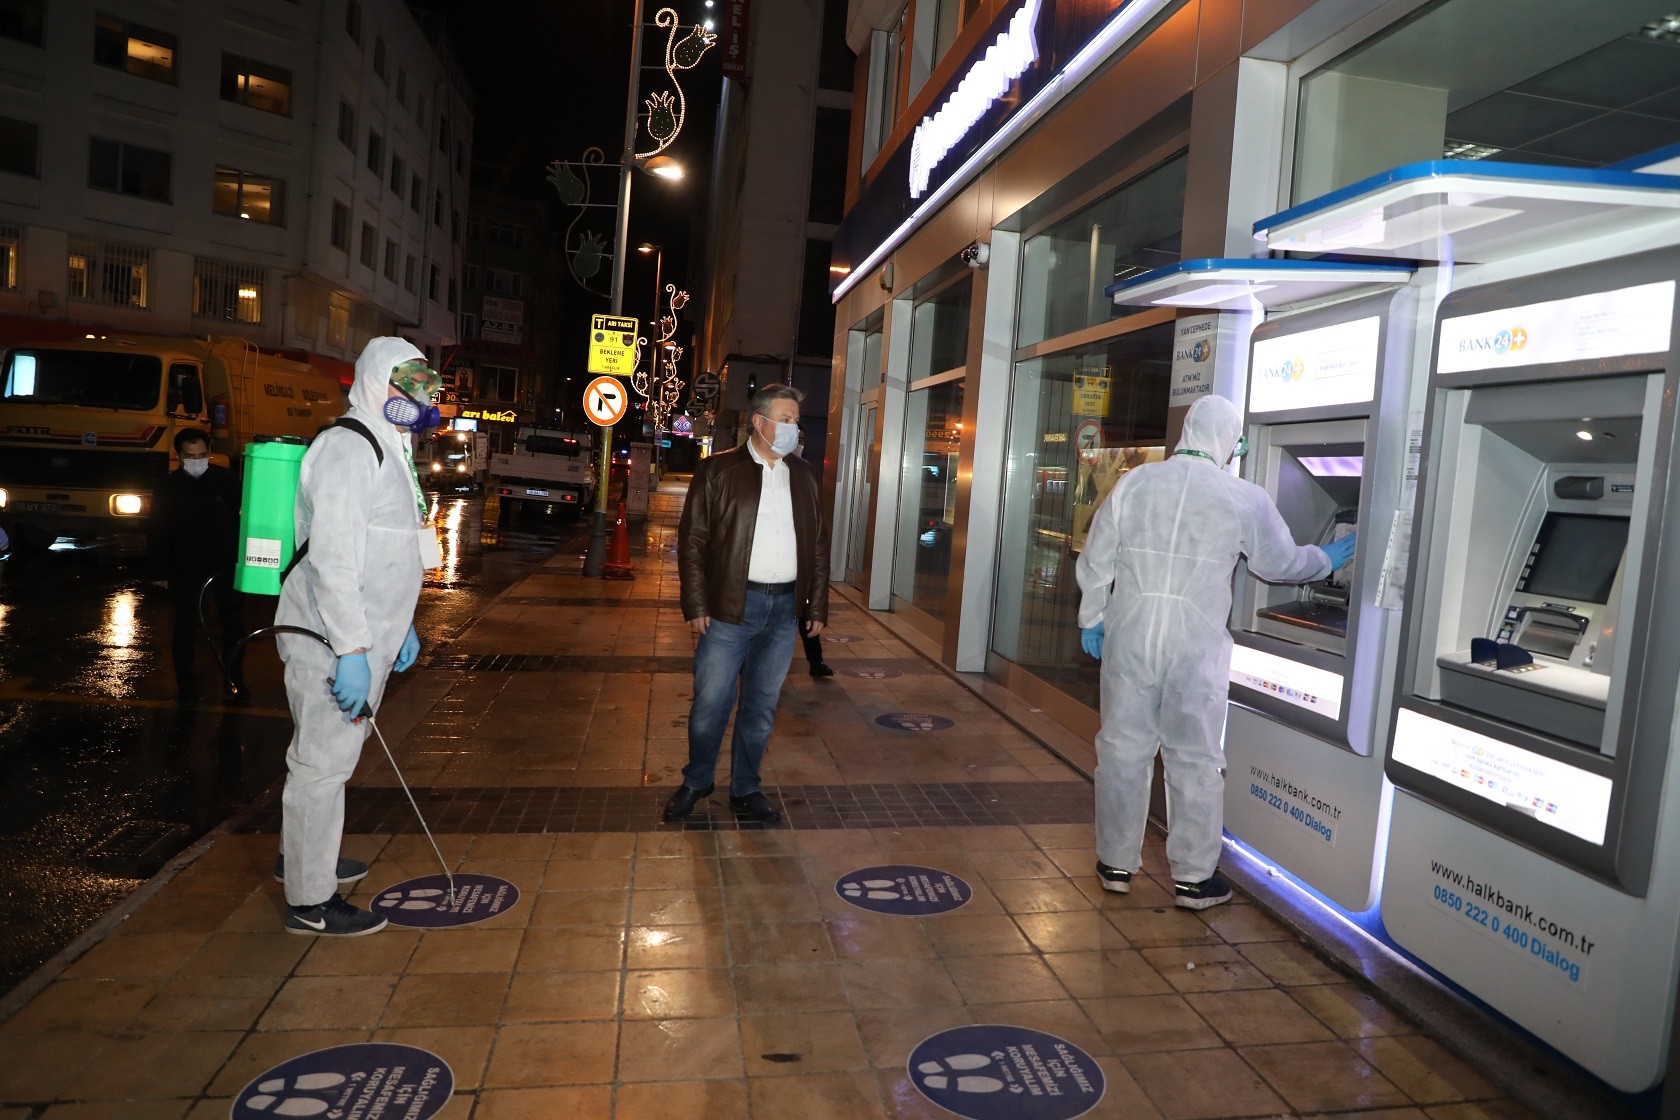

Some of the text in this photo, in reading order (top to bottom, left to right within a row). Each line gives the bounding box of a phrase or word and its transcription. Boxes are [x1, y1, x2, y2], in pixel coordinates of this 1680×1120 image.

[595, 318, 604, 329] T
[1180, 322, 1212, 336] YAN CEPHEDE
[599, 348, 625, 356] BEKLEME
[1458, 334, 1511, 354] BANK 24
[1176, 350, 1194, 361] BANK
[1172, 384, 1211, 397] BULUNMAKTADIR
[1250, 764, 1342, 820] www.halkbank.com.tr
[1250, 783, 1332, 841] 0850 222 0 400 Dialog
[1431, 859, 1595, 955] www.halkbank.com.tr
[1433, 885, 1581, 982] 0850 222 0 400 Dialog
[1005, 1046, 1044, 1096] KORUYALIM
[1021, 1044, 1064, 1096] MESAFEMİZİ
[1047, 1059, 1067, 1078] İÇİN
[1054, 1043, 1094, 1093] SAĞLIĞIMIZ
[393, 1084, 417, 1104] İÇİN
